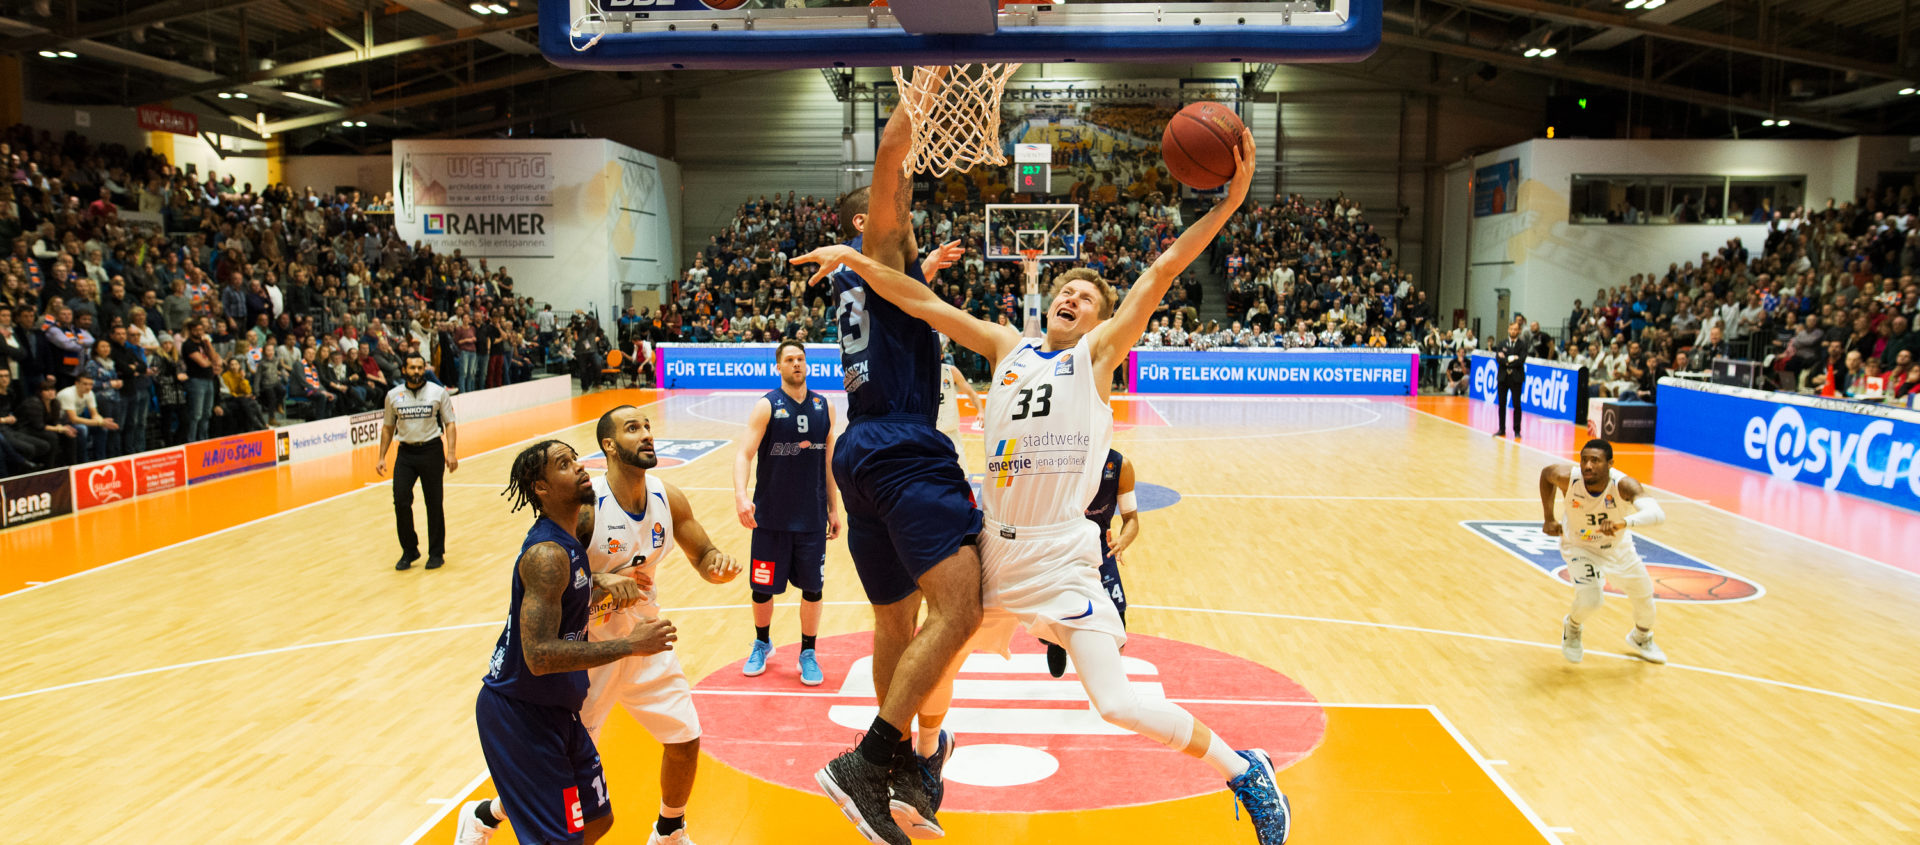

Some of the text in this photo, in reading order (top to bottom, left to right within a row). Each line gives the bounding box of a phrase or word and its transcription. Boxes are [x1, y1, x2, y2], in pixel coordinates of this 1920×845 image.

[448, 182, 493, 191] architekten
[503, 182, 545, 194] ingenieure
[446, 213, 546, 235] RAHMER
[667, 360, 695, 376] FÜR
[698, 363, 767, 377] TELEKOM
[769, 364, 831, 377] KDEN
[1139, 364, 1407, 383] FÜR TELEKOM KUNDEN KOSTENFREI
[1011, 383, 1053, 420] 33
[797, 415, 809, 433] 9
[1022, 431, 1090, 448] stadtwerke
[988, 456, 1032, 473] energie
[1585, 513, 1609, 526] 32
